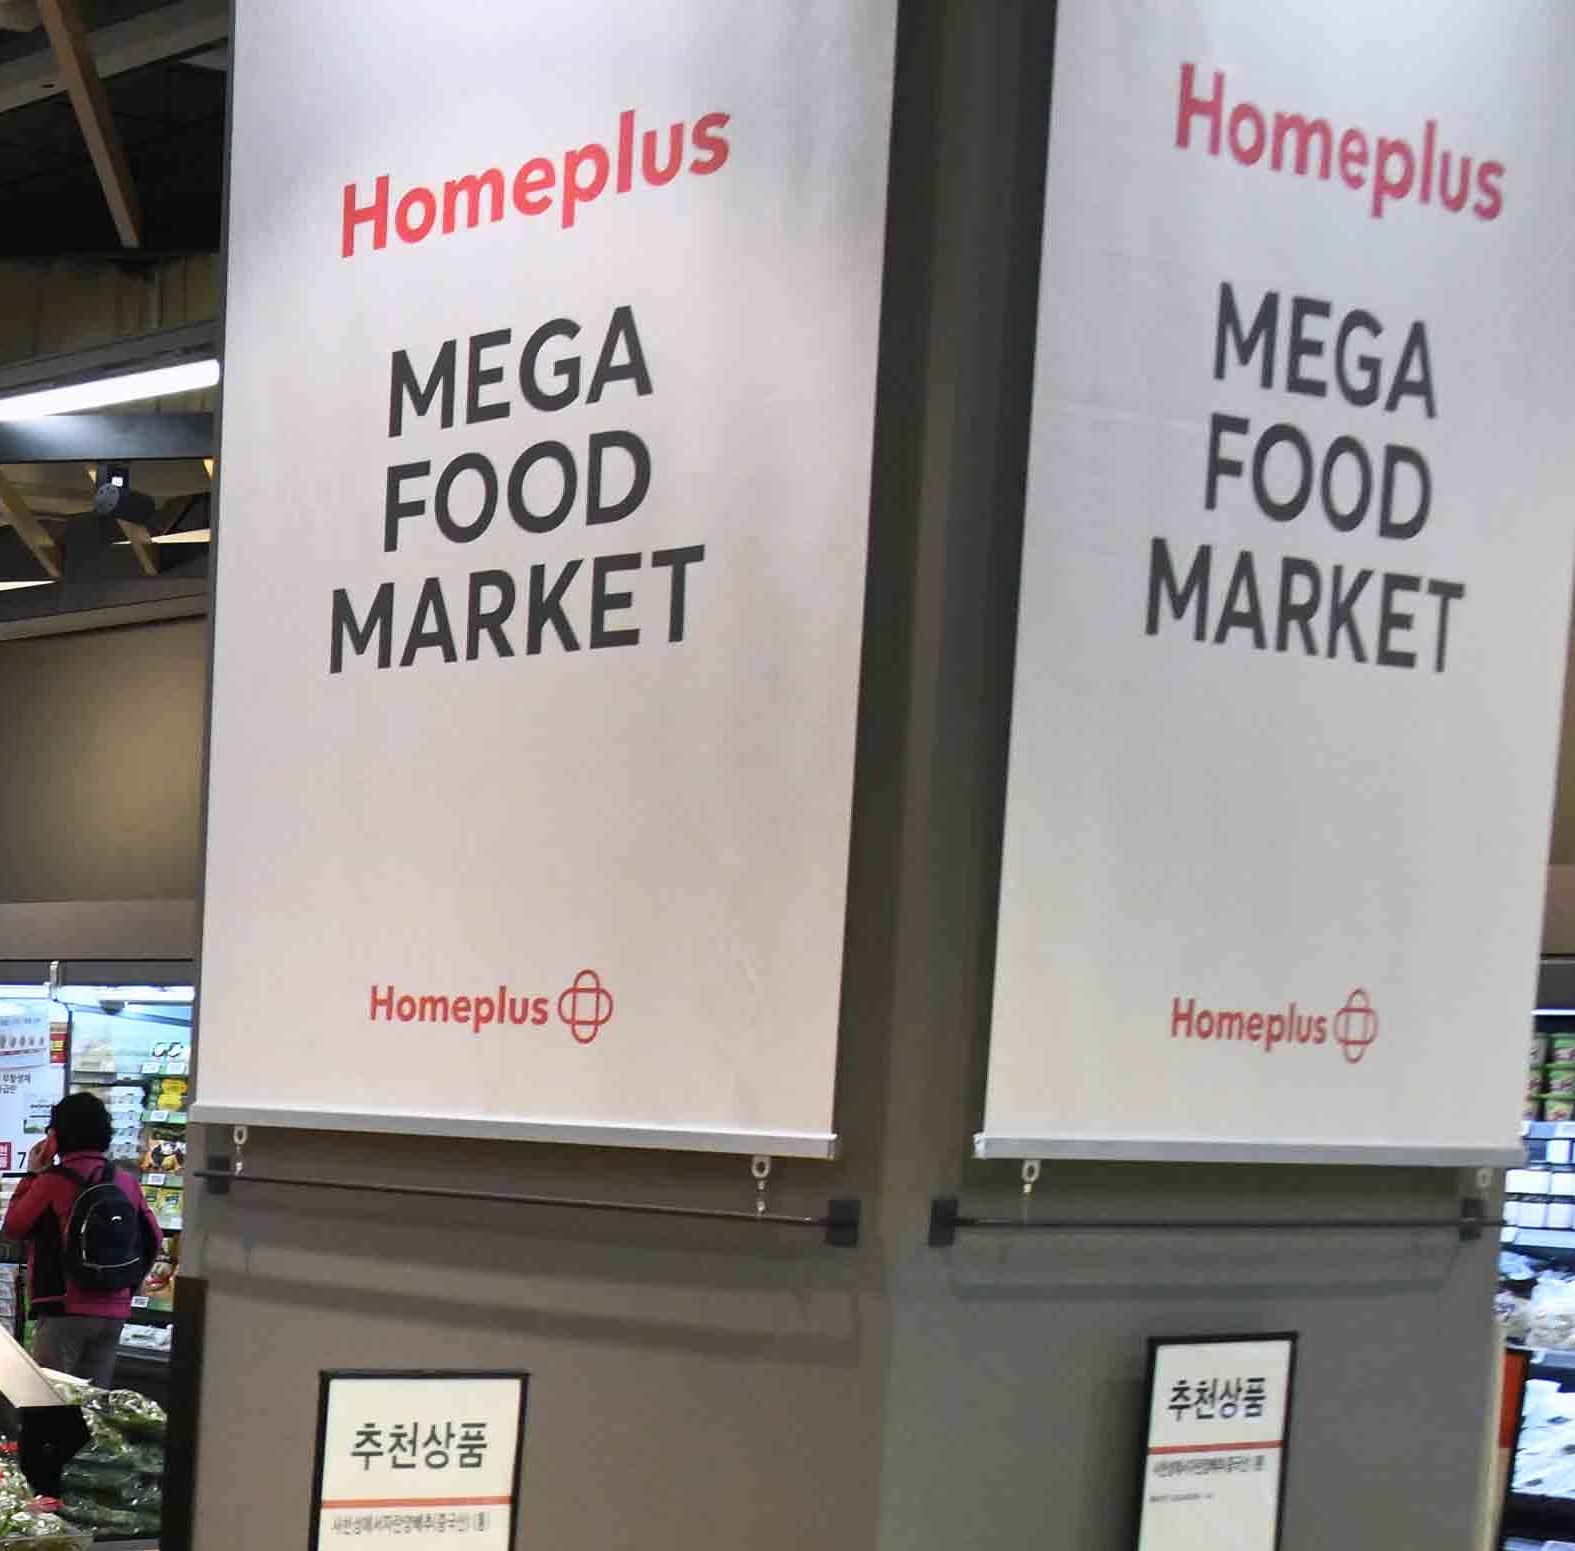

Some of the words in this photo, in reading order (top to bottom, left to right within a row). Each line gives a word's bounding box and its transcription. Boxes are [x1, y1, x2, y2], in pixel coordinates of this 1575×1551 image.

[341, 108, 732, 259] Homeplus
[1175, 60, 1506, 223] Homeplus
[388, 304, 654, 439] MEGA
[1212, 279, 1438, 420] MEGA
[383, 429, 653, 553] FOOD
[1204, 411, 1433, 541] FOOD
[328, 543, 706, 675] MARKET
[1145, 536, 1466, 674] MARKET
[369, 984, 549, 1035] Homeplus
[1170, 995, 1328, 1053] Homeplus
[350, 1420, 488, 1471] 추천상품
[1167, 1377, 1267, 1423] 추천상품
